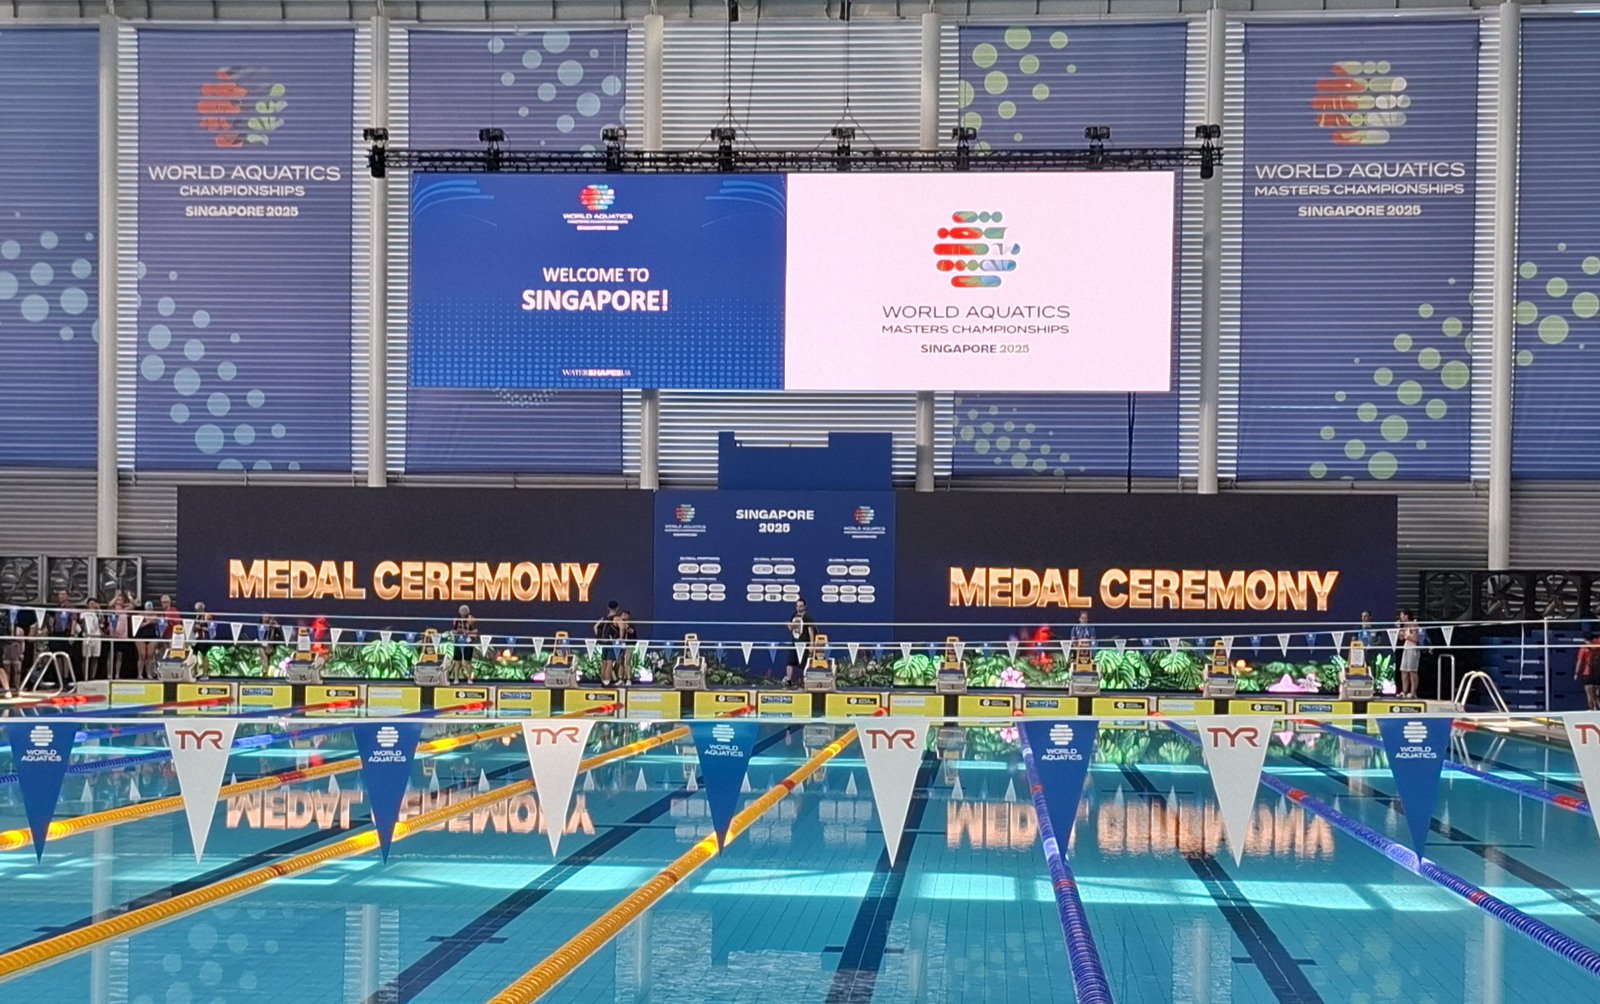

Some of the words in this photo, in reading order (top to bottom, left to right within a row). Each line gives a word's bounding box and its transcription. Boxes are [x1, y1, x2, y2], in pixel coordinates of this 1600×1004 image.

[148, 165, 225, 180] WORLD
[230, 165, 341, 181] AQUATICS
[1254, 163, 1343, 179] WORLD
[1348, 162, 1466, 179] AQUATICS
[179, 185, 306, 197] CHAMPIONSHIPS
[1254, 185, 1331, 196] MASTERS
[1333, 183, 1465, 195] CHAMPIONSHIPS
[185, 205, 265, 217] SINGAPORE
[266, 205, 299, 217] 2025
[1297, 205, 1386, 217] SINGAPORE
[1387, 204, 1422, 216] 2025
[542, 266, 625, 283] WELCOME
[627, 267, 650, 283] TO
[521, 289, 669, 311] SINGAPORE!
[882, 305, 960, 319] WORLD
[965, 305, 1071, 320] AQUATICS
[881, 324, 949, 334] MASTERS
[952, 324, 1070, 334] CHAMPIONSHIPS
[920, 344, 998, 354] SINGAPORE
[998, 344, 1030, 354] 2025
[735, 509, 815, 521] SINGAPORE
[758, 522, 791, 533] 2025
[229, 558, 366, 600] MEDAL
[373, 560, 600, 602] CEREMONY
[949, 566, 1092, 609] MEDAL
[1100, 568, 1339, 611] CEREMONY
[174, 729, 224, 750] TYR
[531, 726, 580, 746] TYR
[865, 729, 916, 750] TYR
[1206, 727, 1260, 748] TYR
[1574, 724, 1600, 745] TY
[20, 755, 62, 763] AQUATICS
[703, 750, 744, 758] AQUATICS
[1394, 752, 1437, 760] AQUATICS
